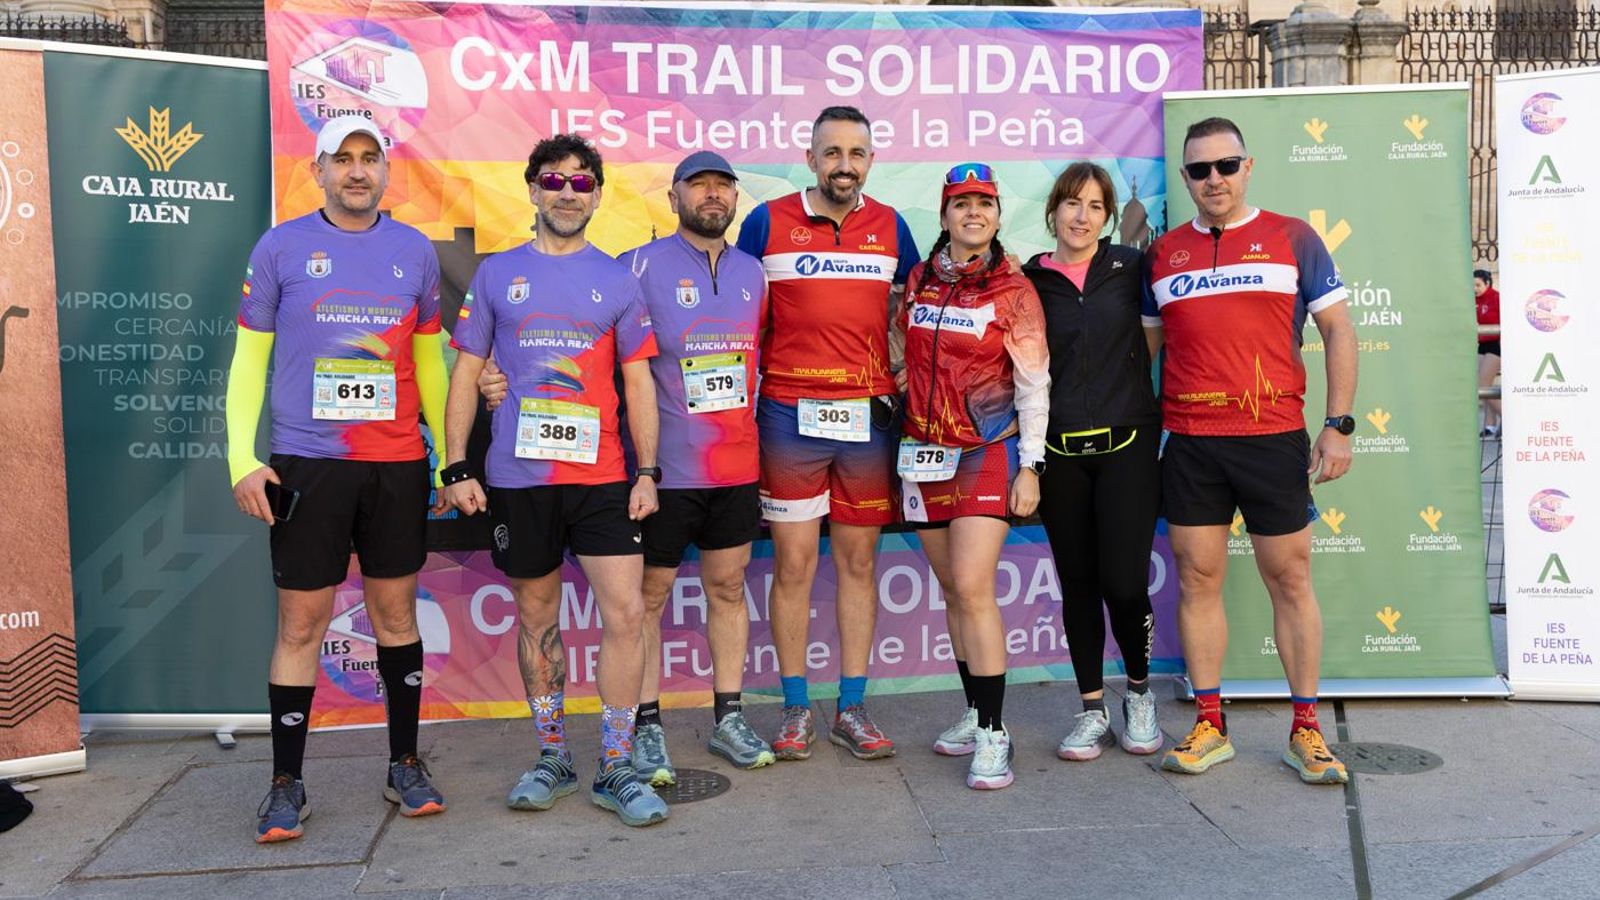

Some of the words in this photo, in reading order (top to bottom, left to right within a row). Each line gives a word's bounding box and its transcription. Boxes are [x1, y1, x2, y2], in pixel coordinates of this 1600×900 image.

[450, 37, 589, 93] CxM
[612, 42, 804, 96] TRAIL
[825, 43, 1171, 96] SOLIDARIO
[297, 83, 326, 99] IES
[647, 110, 813, 150] Fuente
[912, 109, 949, 148] la
[968, 109, 1085, 148] Peña
[1292, 144, 1344, 155] Fundación
[1392, 140, 1443, 152] Fundación
[82, 176, 144, 197] CAJA
[150, 178, 234, 201] RURAL
[128, 202, 190, 224] JAÉN
[821, 259, 881, 274] Avanza
[1195, 274, 1263, 290] Avanza
[57, 292, 193, 310] MPROMISO
[316, 313, 370, 324] MANCHA
[373, 315, 403, 326] REAL
[1359, 307, 1402, 325] JAÉN
[115, 316, 239, 336] CERCANÍA
[520, 338, 565, 348] MANCHA
[567, 339, 595, 350] REAL
[685, 342, 727, 351] MANCHA
[730, 342, 755, 350] REAL
[59, 344, 204, 362] ONESTIDAD
[94, 369, 229, 386] TRANSPAR
[705, 375, 733, 391] 579
[338, 383, 375, 399] 613
[114, 395, 227, 412] SOLVENC
[817, 409, 850, 423] 303
[153, 417, 226, 434] SOLID
[539, 423, 577, 441] 388
[1540, 421, 1560, 432] IES
[1355, 434, 1406, 446] Fundación
[1527, 436, 1573, 447] FUENTE
[128, 443, 228, 459] CALIDA
[915, 450, 945, 464] 578
[1516, 451, 1532, 461] DE
[1535, 451, 1549, 461] LA
[1553, 449, 1585, 461] PEÑA
[1410, 532, 1458, 544] Fundación
[470, 582, 603, 636] CM
[1546, 623, 1566, 634] IES
[1365, 634, 1416, 645] Fundación
[1534, 638, 1580, 649] FUENTE
[323, 640, 351, 655] IES
[342, 659, 380, 672] Fuen
[1522, 653, 1538, 664] DE
[1542, 654, 1558, 664] LA
[1560, 651, 1593, 665] PEÑA
